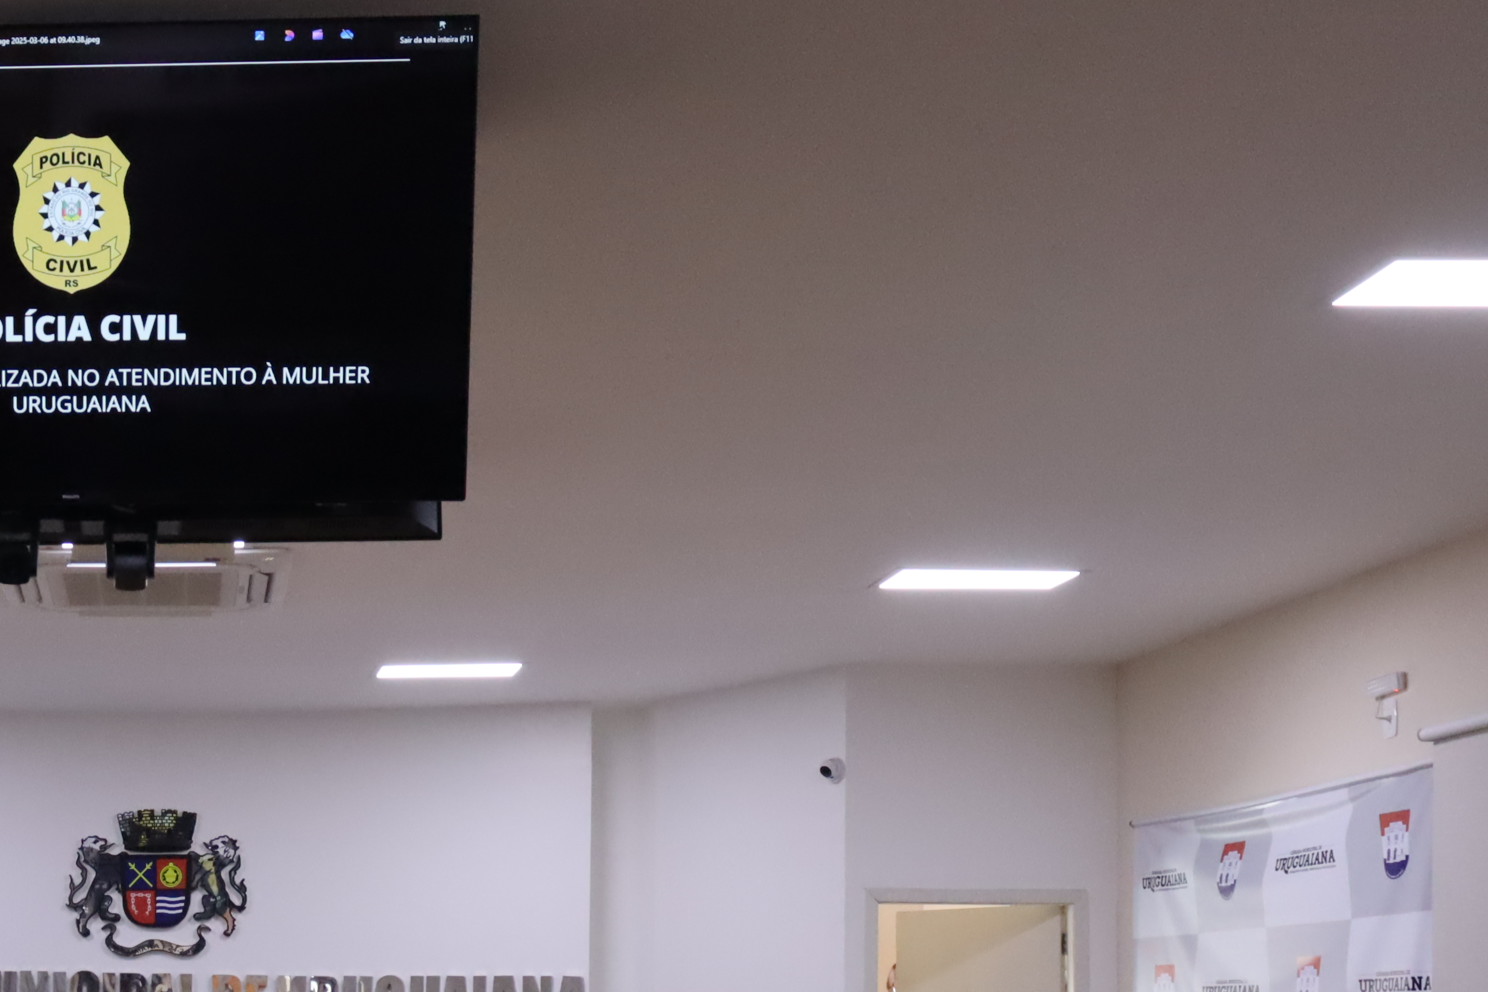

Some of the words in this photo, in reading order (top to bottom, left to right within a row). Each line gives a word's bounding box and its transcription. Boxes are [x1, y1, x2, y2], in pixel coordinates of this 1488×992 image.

[11, 36, 49, 45] 2025-03-06
[50, 36, 57, 44] at
[39, 147, 103, 169] POLÍCIA
[46, 258, 98, 273] CIVIL
[64, 279, 79, 288] RS
[100, 314, 187, 342] CIVIL
[68, 368, 100, 387] NO
[105, 366, 257, 387] ATENDIMENTO
[262, 361, 277, 385] À
[282, 365, 371, 385] MULHER
[12, 394, 152, 414] URUGUAIANA
[1275, 848, 1336, 874] URUGUAIANA
